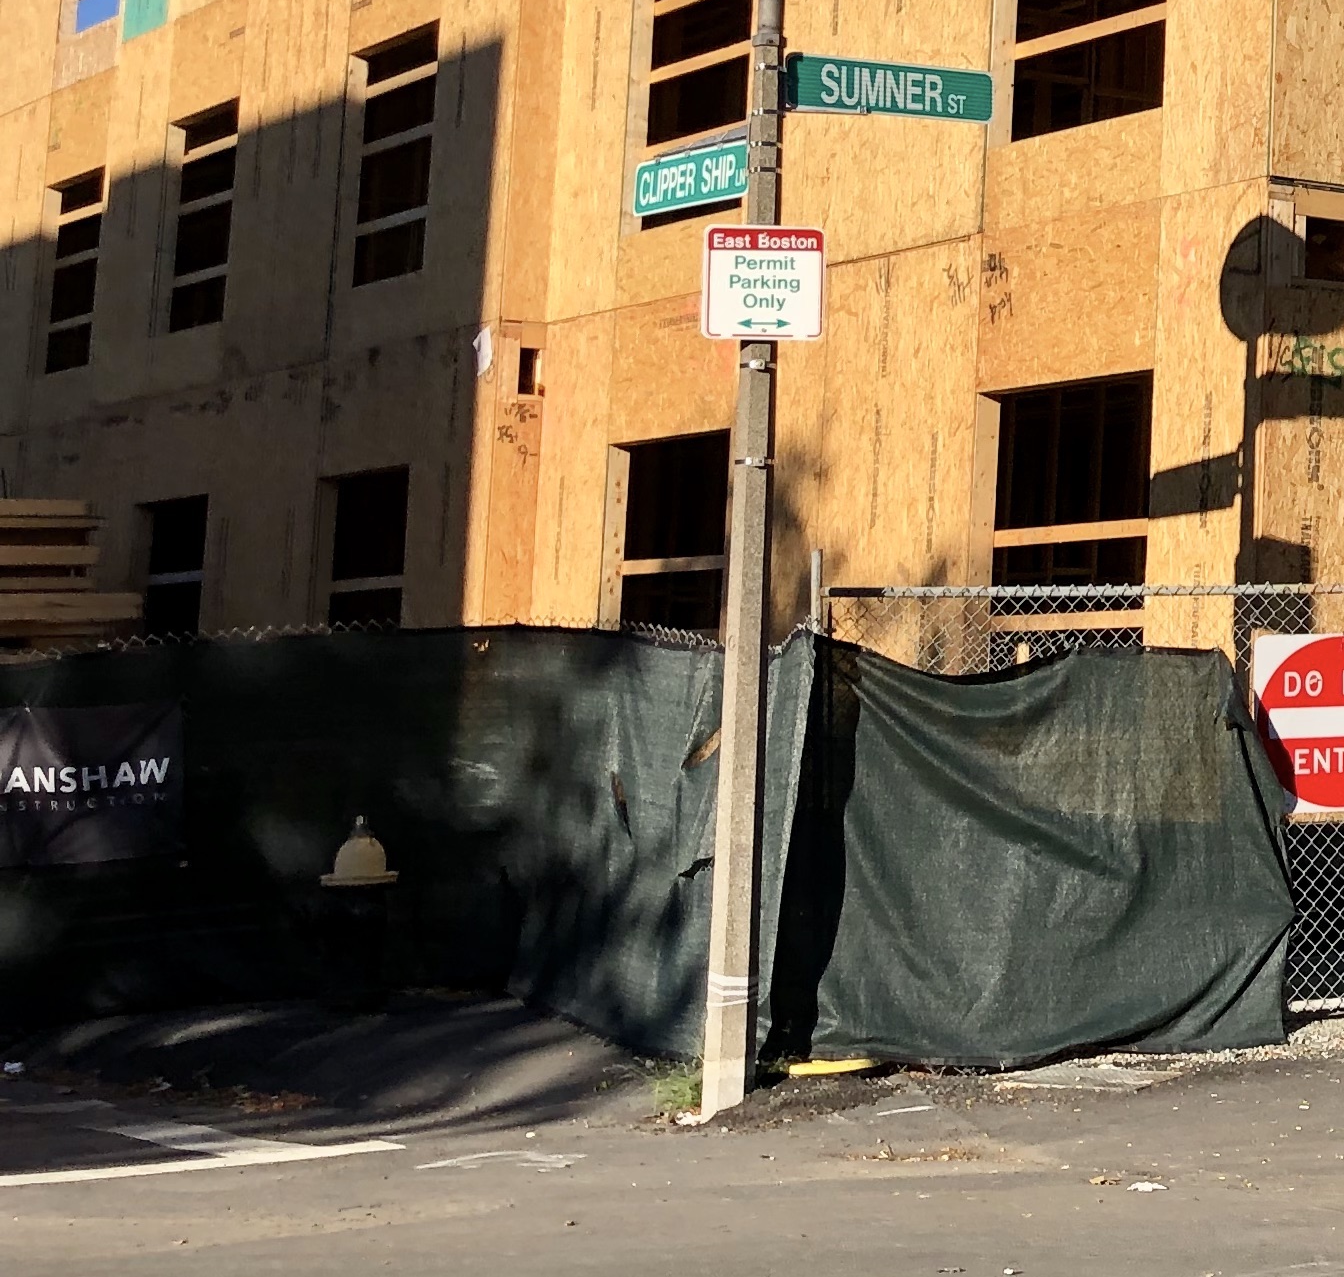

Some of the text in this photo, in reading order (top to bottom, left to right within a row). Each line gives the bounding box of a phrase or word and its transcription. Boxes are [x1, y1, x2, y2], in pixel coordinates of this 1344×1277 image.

[820, 63, 966, 114] SUMNER ST
[639, 154, 746, 206] CLIPPER SHIP LN
[713, 232, 818, 249] East Boston
[734, 255, 795, 270] Permit
[729, 274, 800, 293] Parking
[743, 293, 786, 311] Only
[1283, 670, 1323, 697] DO
[0, 757, 170, 794] ANSHAW
